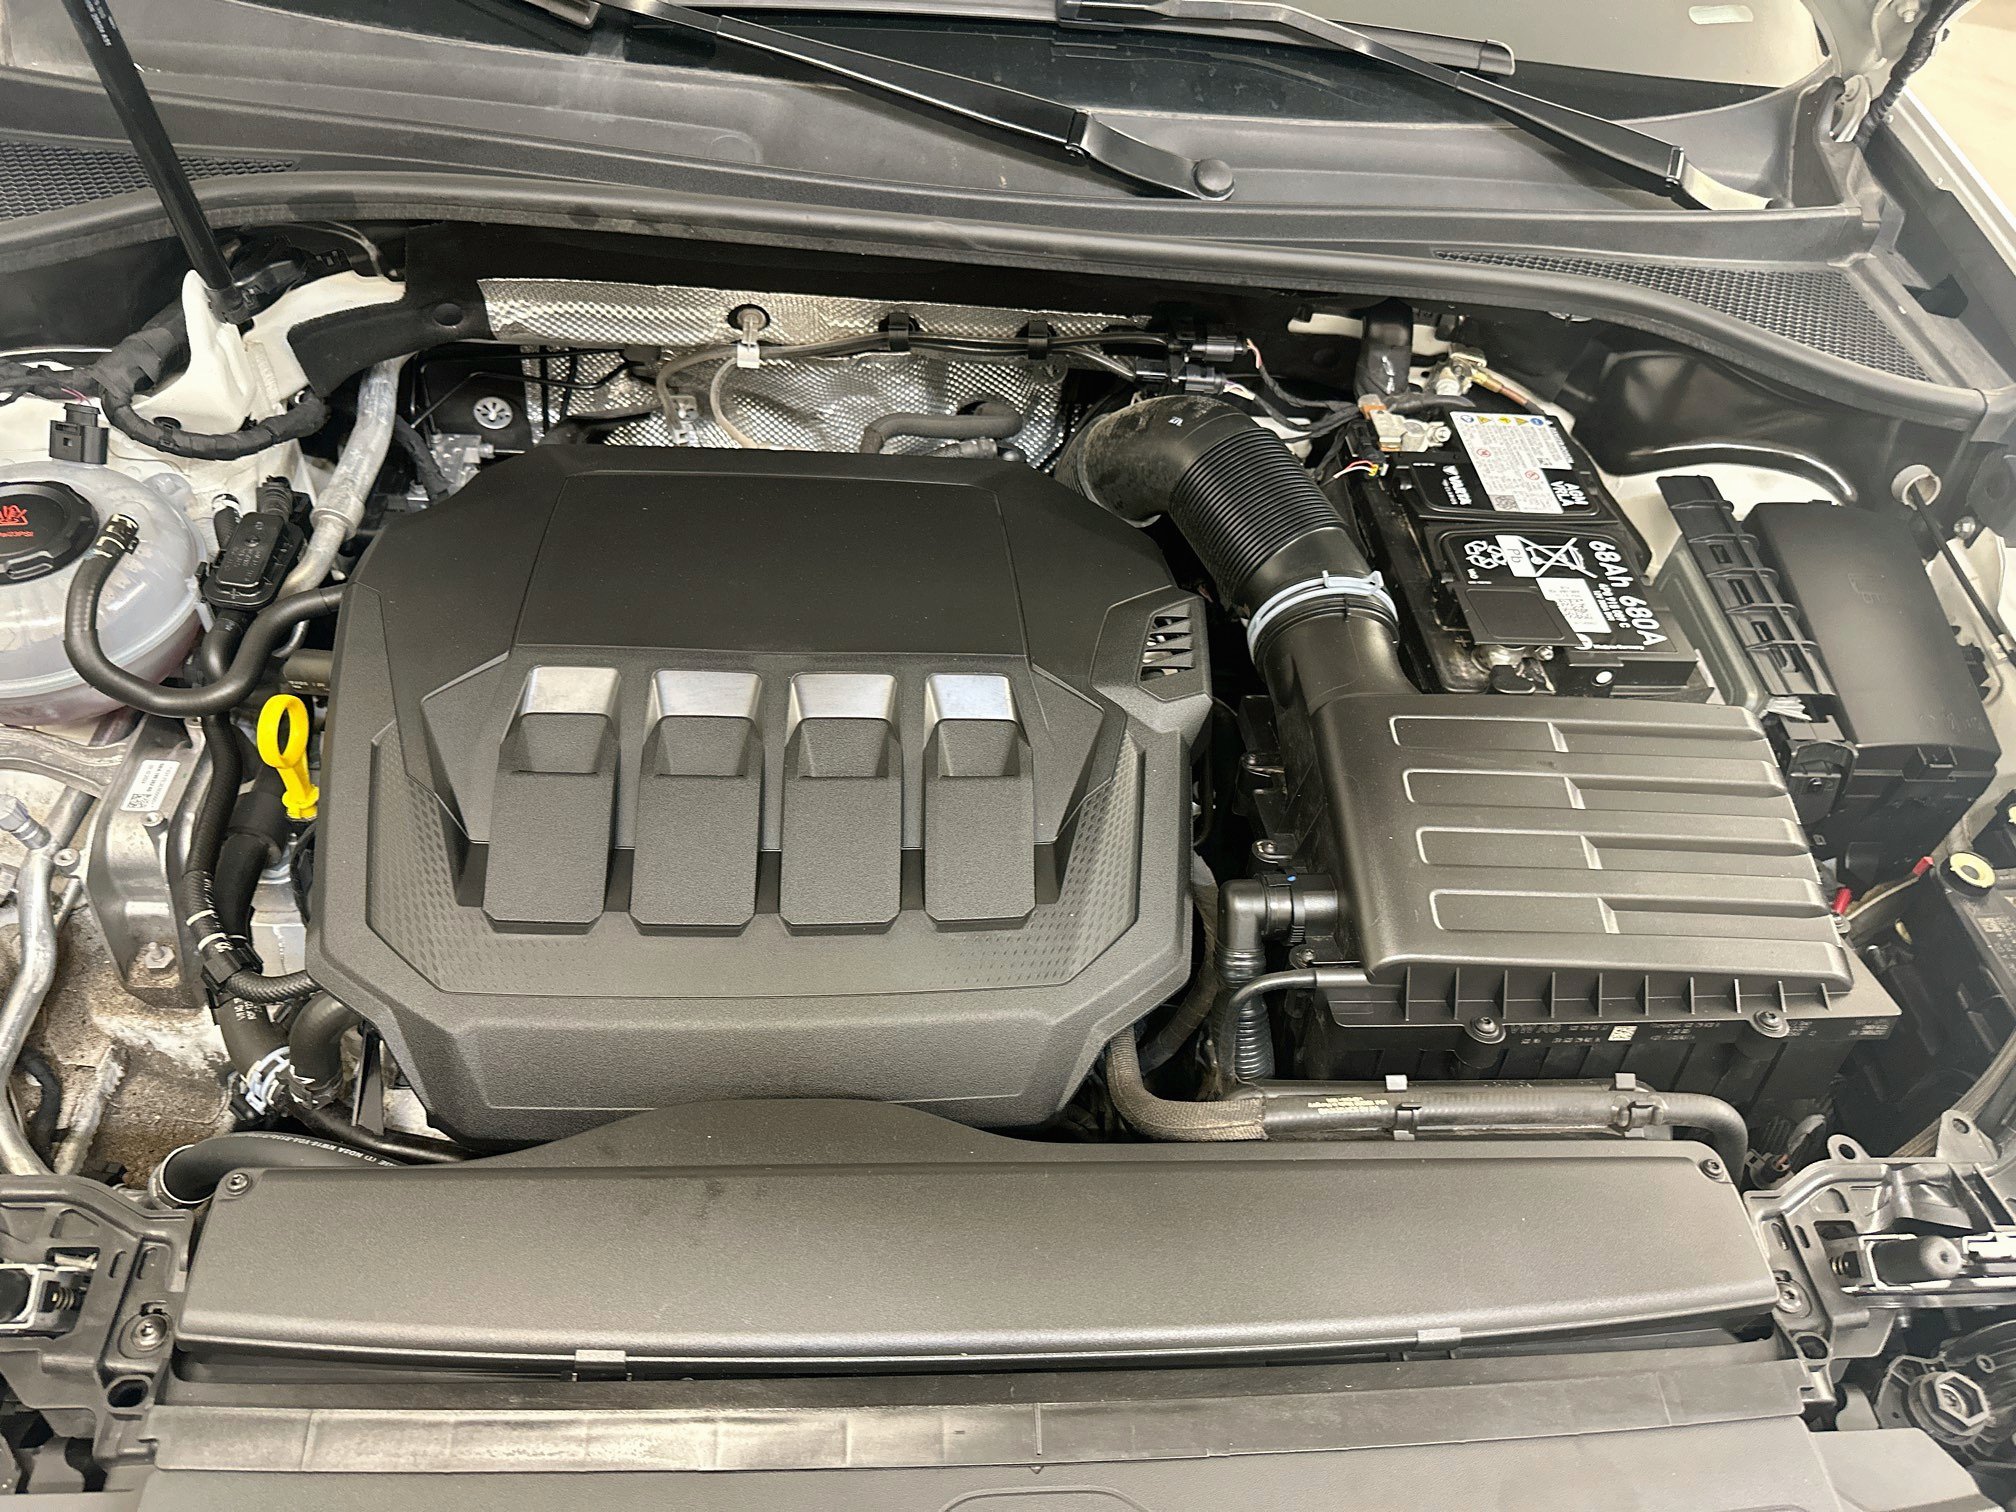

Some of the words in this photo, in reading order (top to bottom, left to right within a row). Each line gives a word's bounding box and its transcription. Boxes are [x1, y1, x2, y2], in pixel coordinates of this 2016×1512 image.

[1449, 475, 1472, 506] VARTA
[1551, 480, 1575, 507] VRLA
[1565, 483, 1589, 506] AGM
[1507, 548, 1521, 563] Pb
[1588, 540, 1634, 588] 68Ah
[1618, 595, 1668, 646] 680A
